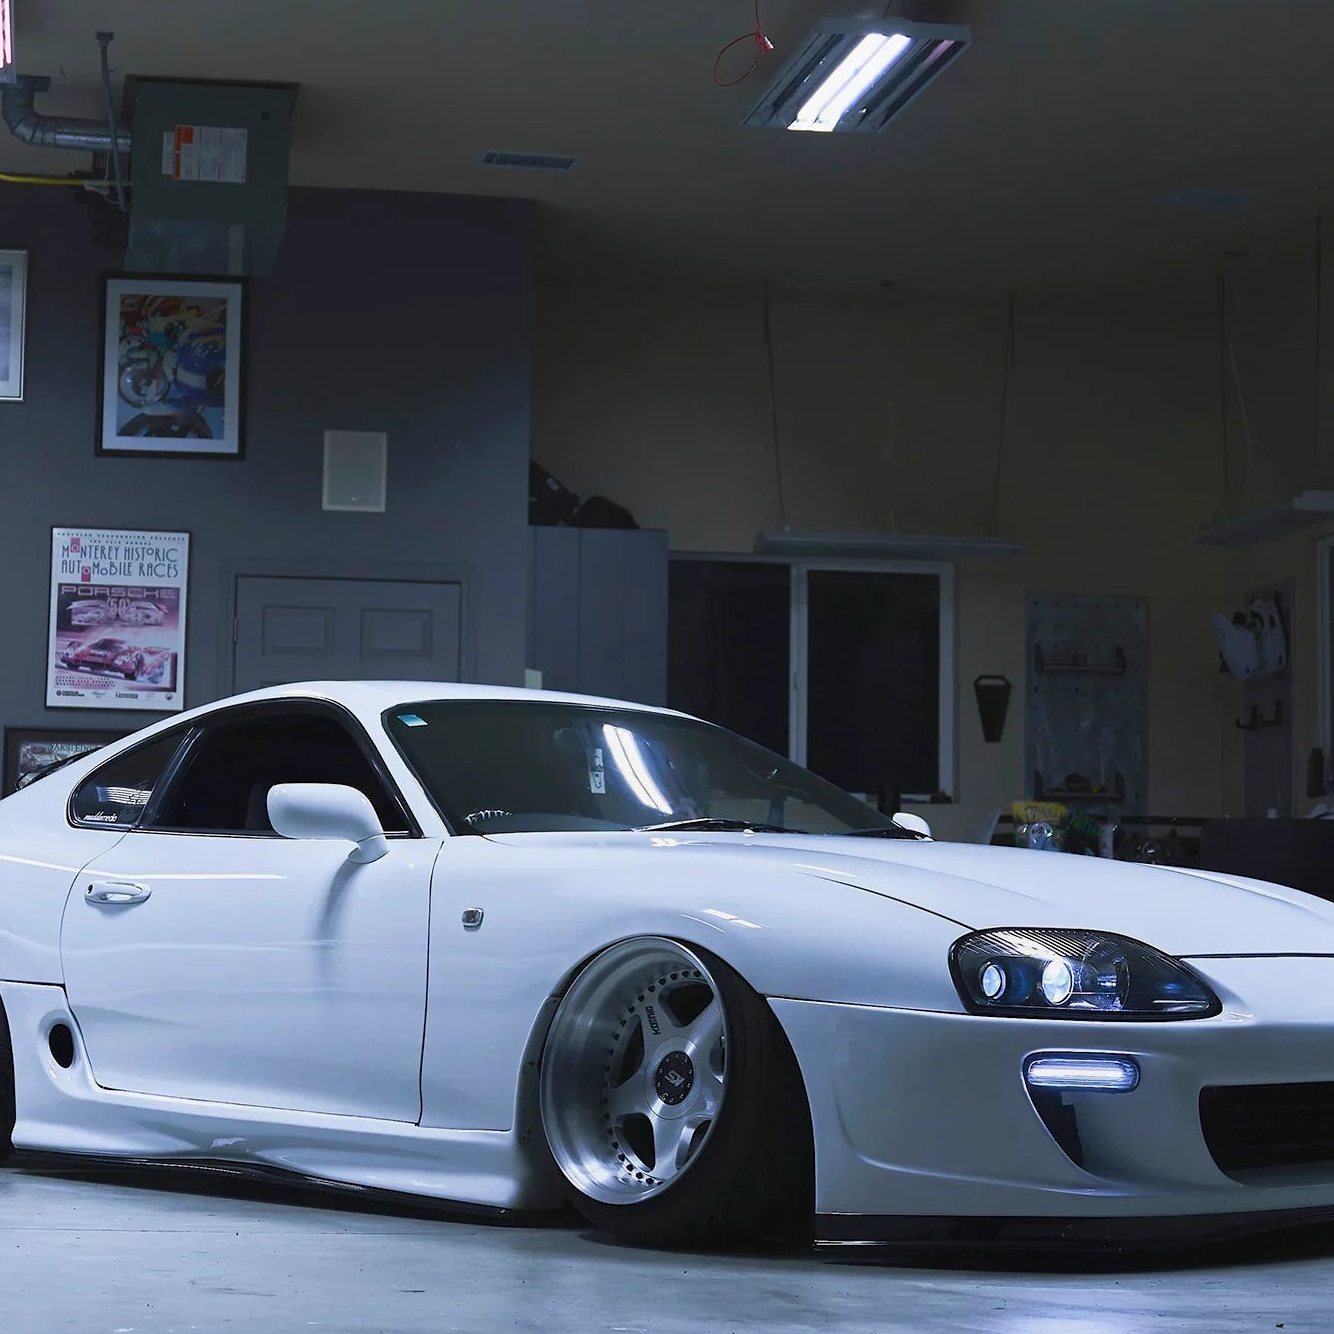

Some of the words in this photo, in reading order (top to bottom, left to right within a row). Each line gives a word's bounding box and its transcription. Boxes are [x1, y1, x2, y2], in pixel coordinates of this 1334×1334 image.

[62, 544, 119, 560] MONTEREY
[124, 547, 178, 563] HISTORIC
[139, 563, 178, 578] RACES
[61, 586, 176, 598] PORSCHE
